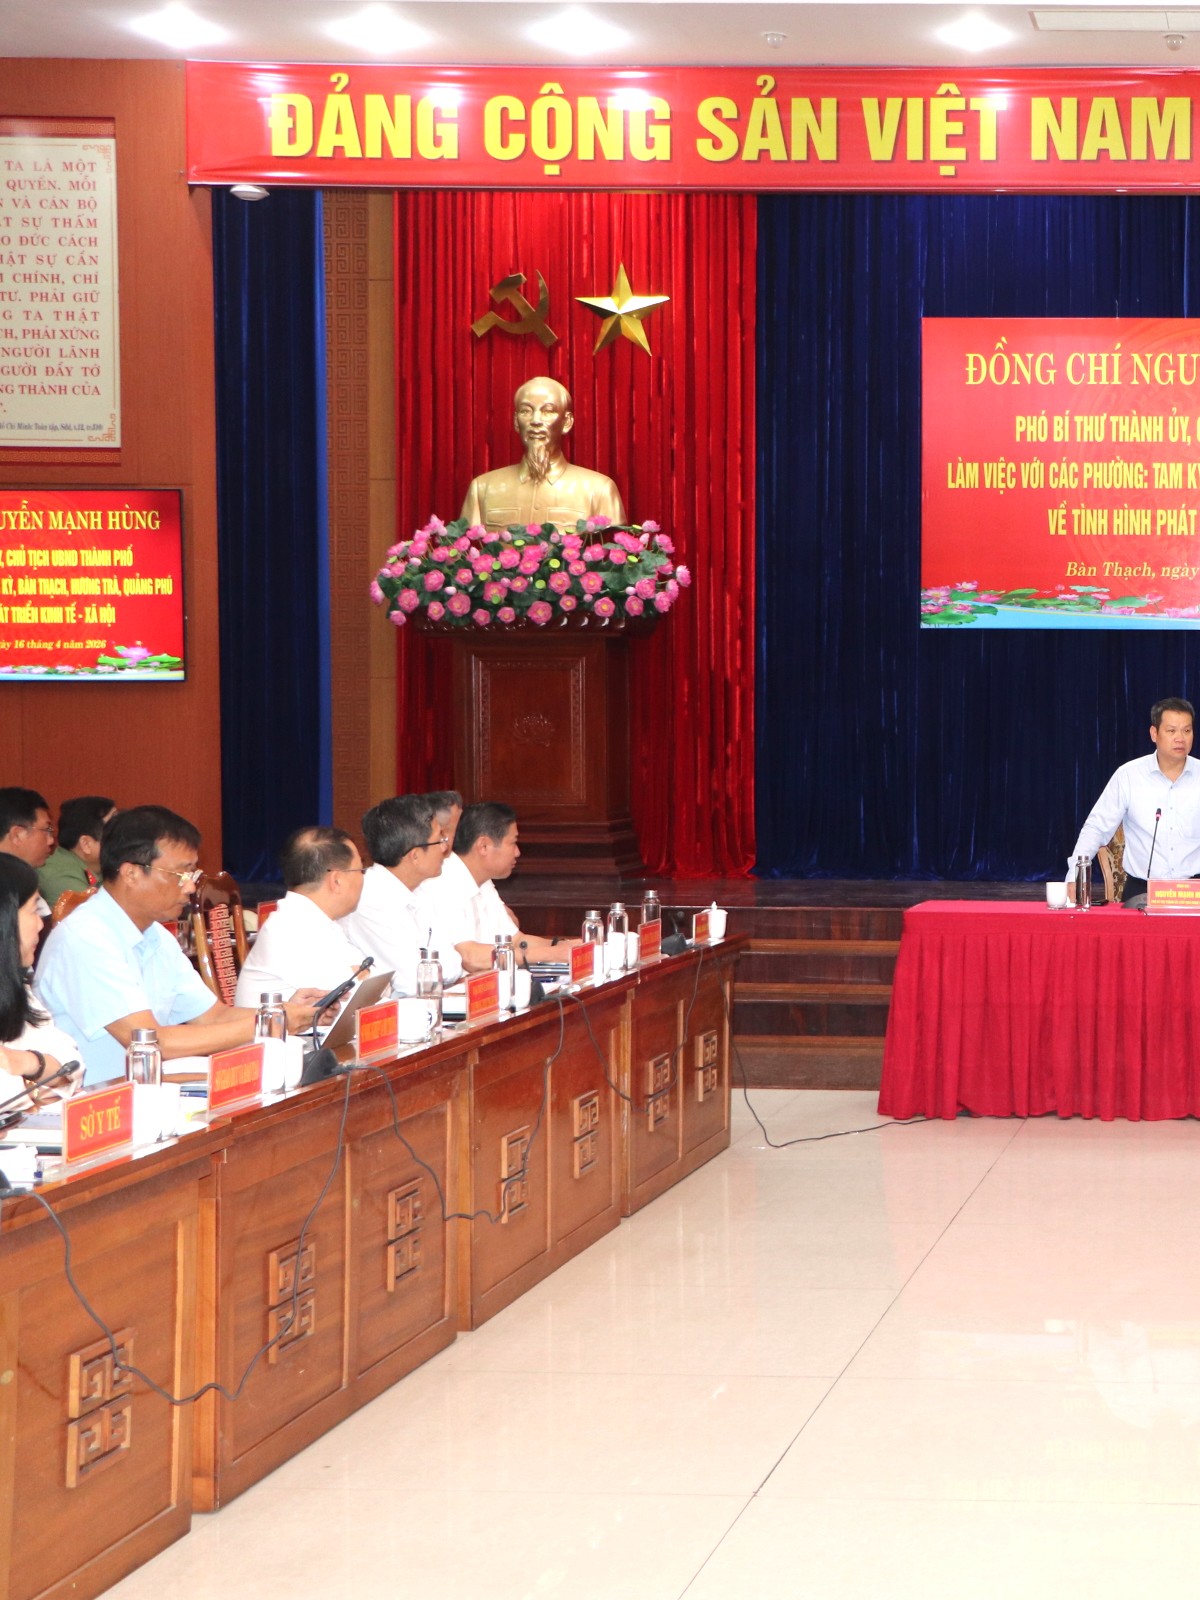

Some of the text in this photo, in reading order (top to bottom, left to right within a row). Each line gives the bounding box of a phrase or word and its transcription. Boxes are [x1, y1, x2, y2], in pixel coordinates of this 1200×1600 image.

[269, 72, 458, 160] ĐẢNG
[484, 82, 672, 175] CỘNG
[696, 75, 838, 160] SẢN
[850, 83, 1008, 176] VIỆT
[1032, 96, 1192, 162] NAM
[4, 158, 97, 175] TA LÀ MỘT
[12, 196, 98, 213] VÀ CÁN BỘ
[22, 216, 43, 230] SỰ
[19, 233, 98, 247] ĐỨC CÁCH
[36, 253, 58, 268] SỰ
[73, 272, 99, 284] CHÍ
[30, 288, 100, 303] PHẢI GIỮ
[24, 308, 100, 324] TA THẬT
[22, 326, 56, 339] PHẢI
[59, 346, 100, 359] LÃNH
[965, 336, 1057, 386] ĐỒNG
[1066, 342, 1123, 386] CHÍ
[82, 363, 101, 377] TỚ
[18, 381, 101, 396] THÀNH CỦA
[1015, 410, 1048, 443] PHÓ
[1053, 410, 1071, 443] BÍ
[1074, 412, 1108, 443] THƯ
[1110, 410, 1164, 443] THÀNH
[1168, 406, 1192, 446] ỦY,
[947, 457, 979, 489] LÀM
[984, 457, 1017, 495] VIỆC
[1021, 457, 1045, 489] VỚI
[1049, 456, 1079, 489] CÁC
[1083, 456, 1149, 489] PHƯỜNG:
[1152, 463, 1183, 489] TAM
[48, 504, 161, 536] MẠNH HÙNG
[1048, 500, 1068, 536] VỀ
[1072, 504, 1108, 536] TÌNH
[1113, 504, 1152, 536] HÌNH
[1156, 504, 1197, 536] PHÁT
[6, 544, 133, 571] CHỦ TỊCH UBND THÀNH PHỐ
[1066, 562, 1097, 577] Bàn
[1102, 562, 1156, 580] Thạch,
[1160, 562, 1200, 579] ngày
[2, 573, 173, 599] KỲ, BÀN THẠCH, HƯƠNG TRÀ, QUẢNG PHÚ
[11, 600, 116, 628] TRIỂN KINH TẾ XÃ HỘI
[14, 640, 107, 651] 16 tháng 4 năm 2026
[80, 1096, 121, 1141] SỞ Y TẾ
